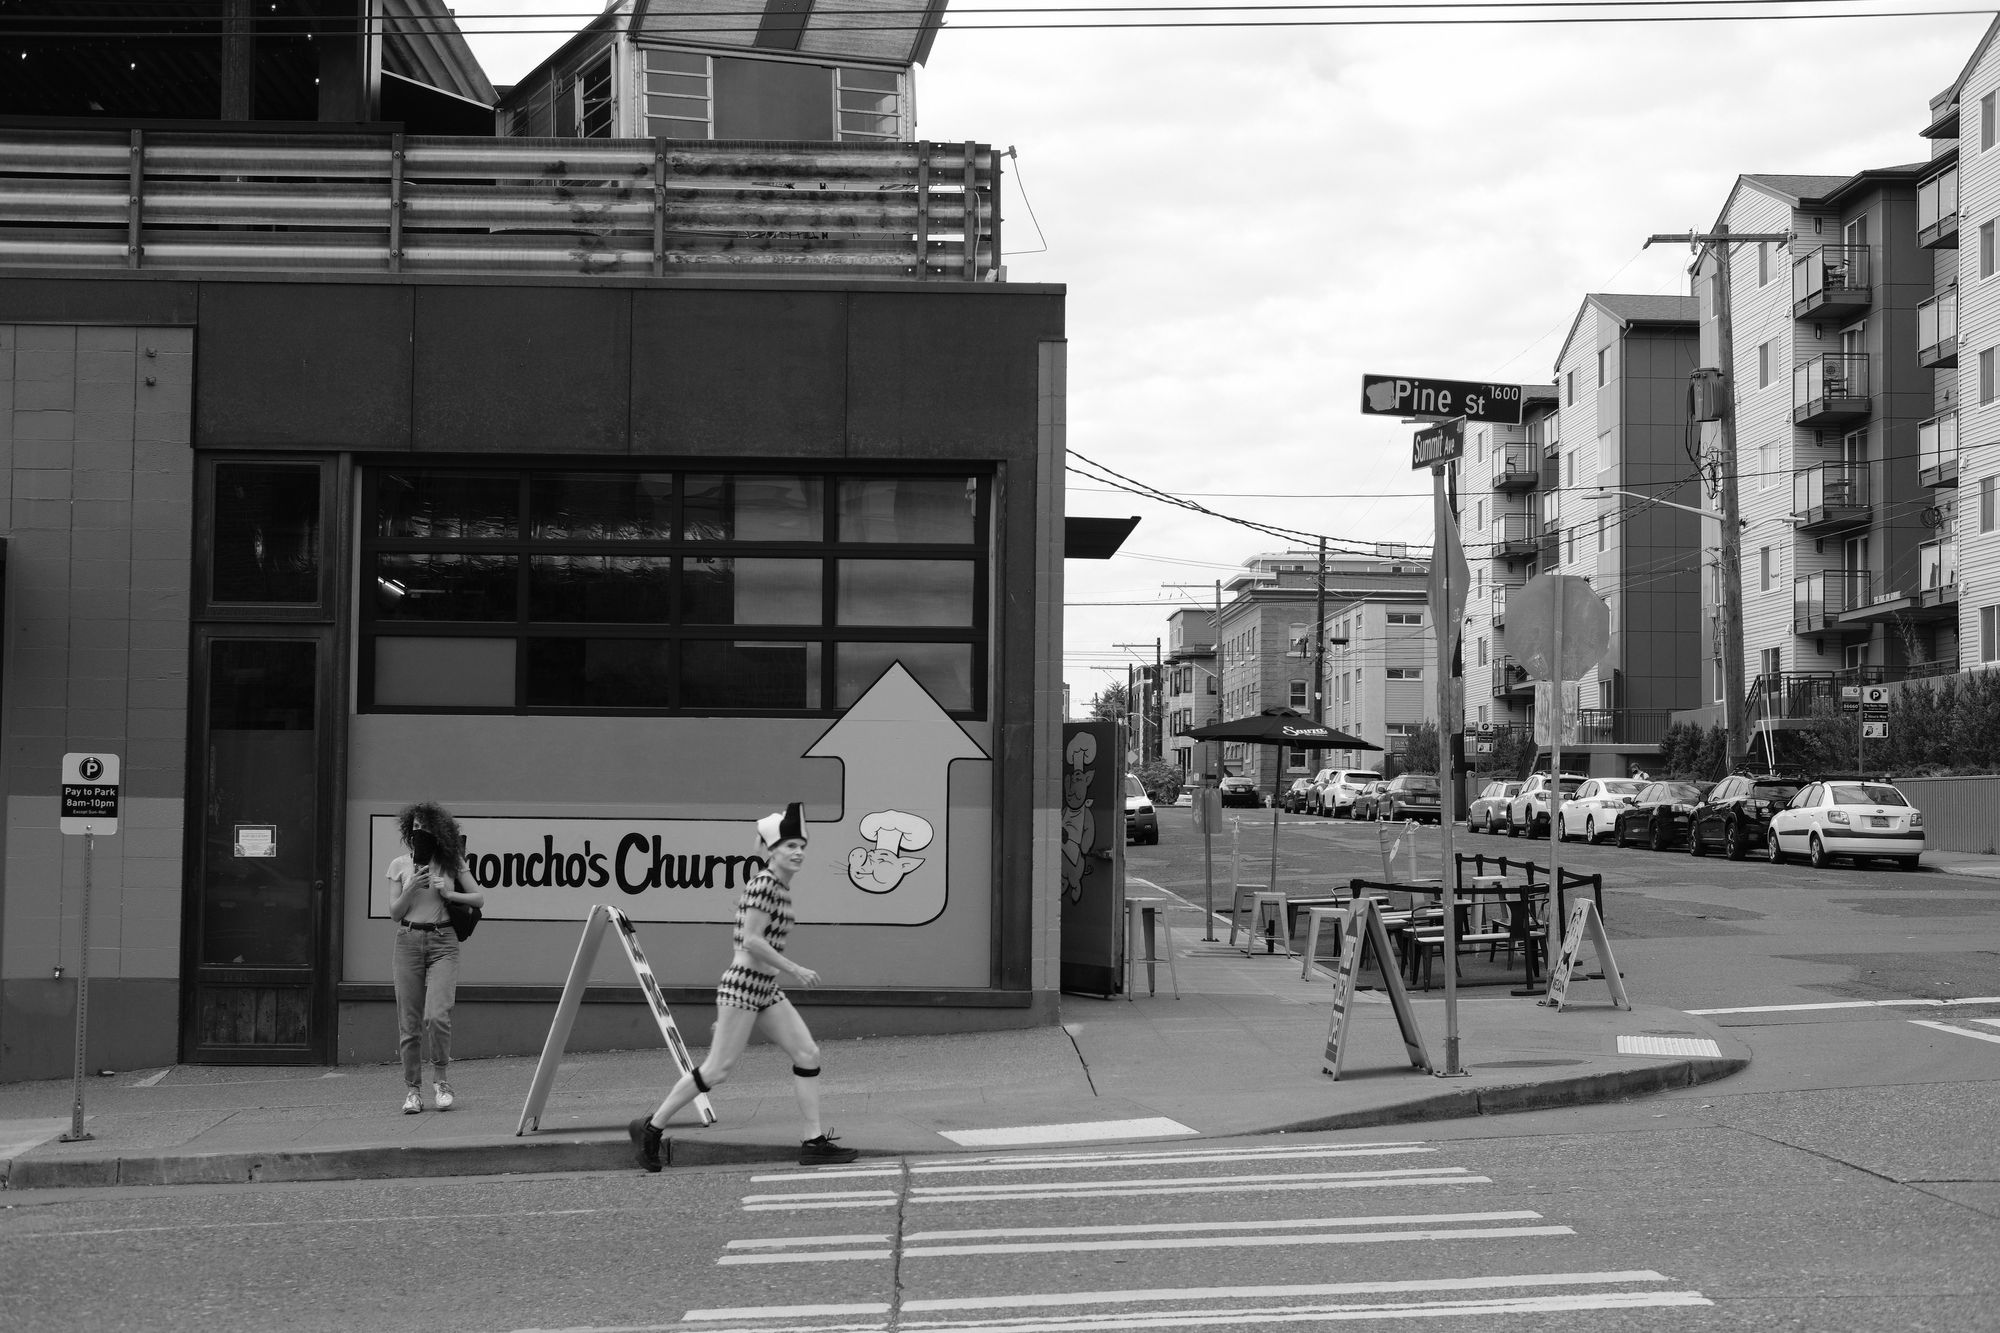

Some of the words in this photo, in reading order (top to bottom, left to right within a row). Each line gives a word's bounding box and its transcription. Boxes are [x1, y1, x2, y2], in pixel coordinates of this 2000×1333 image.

[1394, 380, 1452, 413] Pine
[1465, 393, 1485, 415] St
[1488, 386, 1518, 400] 1600
[1415, 429, 1444, 464] Summit
[1444, 436, 1455, 456] Ave
[86, 762, 98, 776] P
[65, 787, 82, 797] Pay
[83, 787, 93, 796] to
[94, 787, 116, 796] Park
[66, 798, 115, 808] 8am-10pm
[615, 832, 769, 895] Churro
